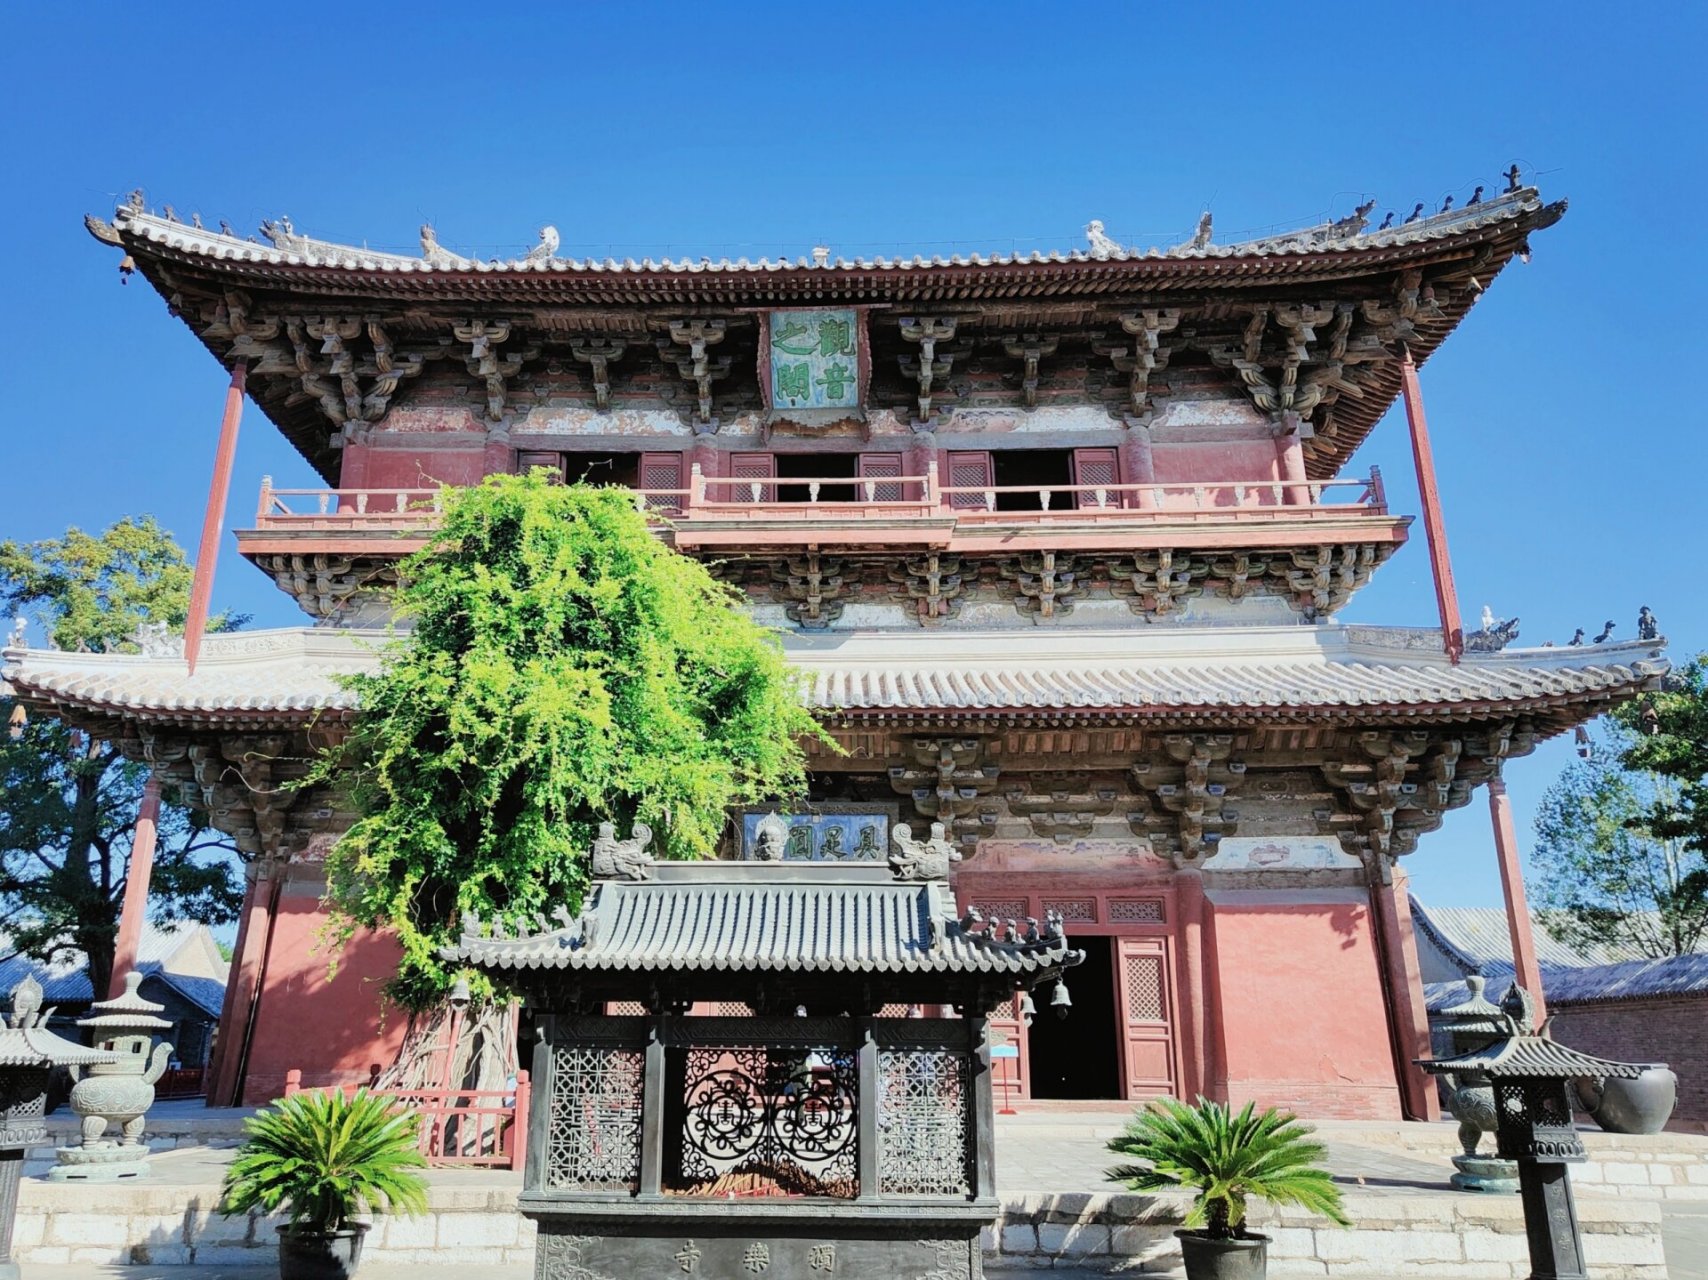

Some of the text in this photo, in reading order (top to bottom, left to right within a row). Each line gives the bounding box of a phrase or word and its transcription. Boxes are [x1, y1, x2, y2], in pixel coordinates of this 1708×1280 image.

[772, 322, 818, 401] 之閣
[816, 319, 856, 400] 觀音
[788, 825, 880, 860] 具足圓
[673, 1239, 835, 1273] 獨樂寺
